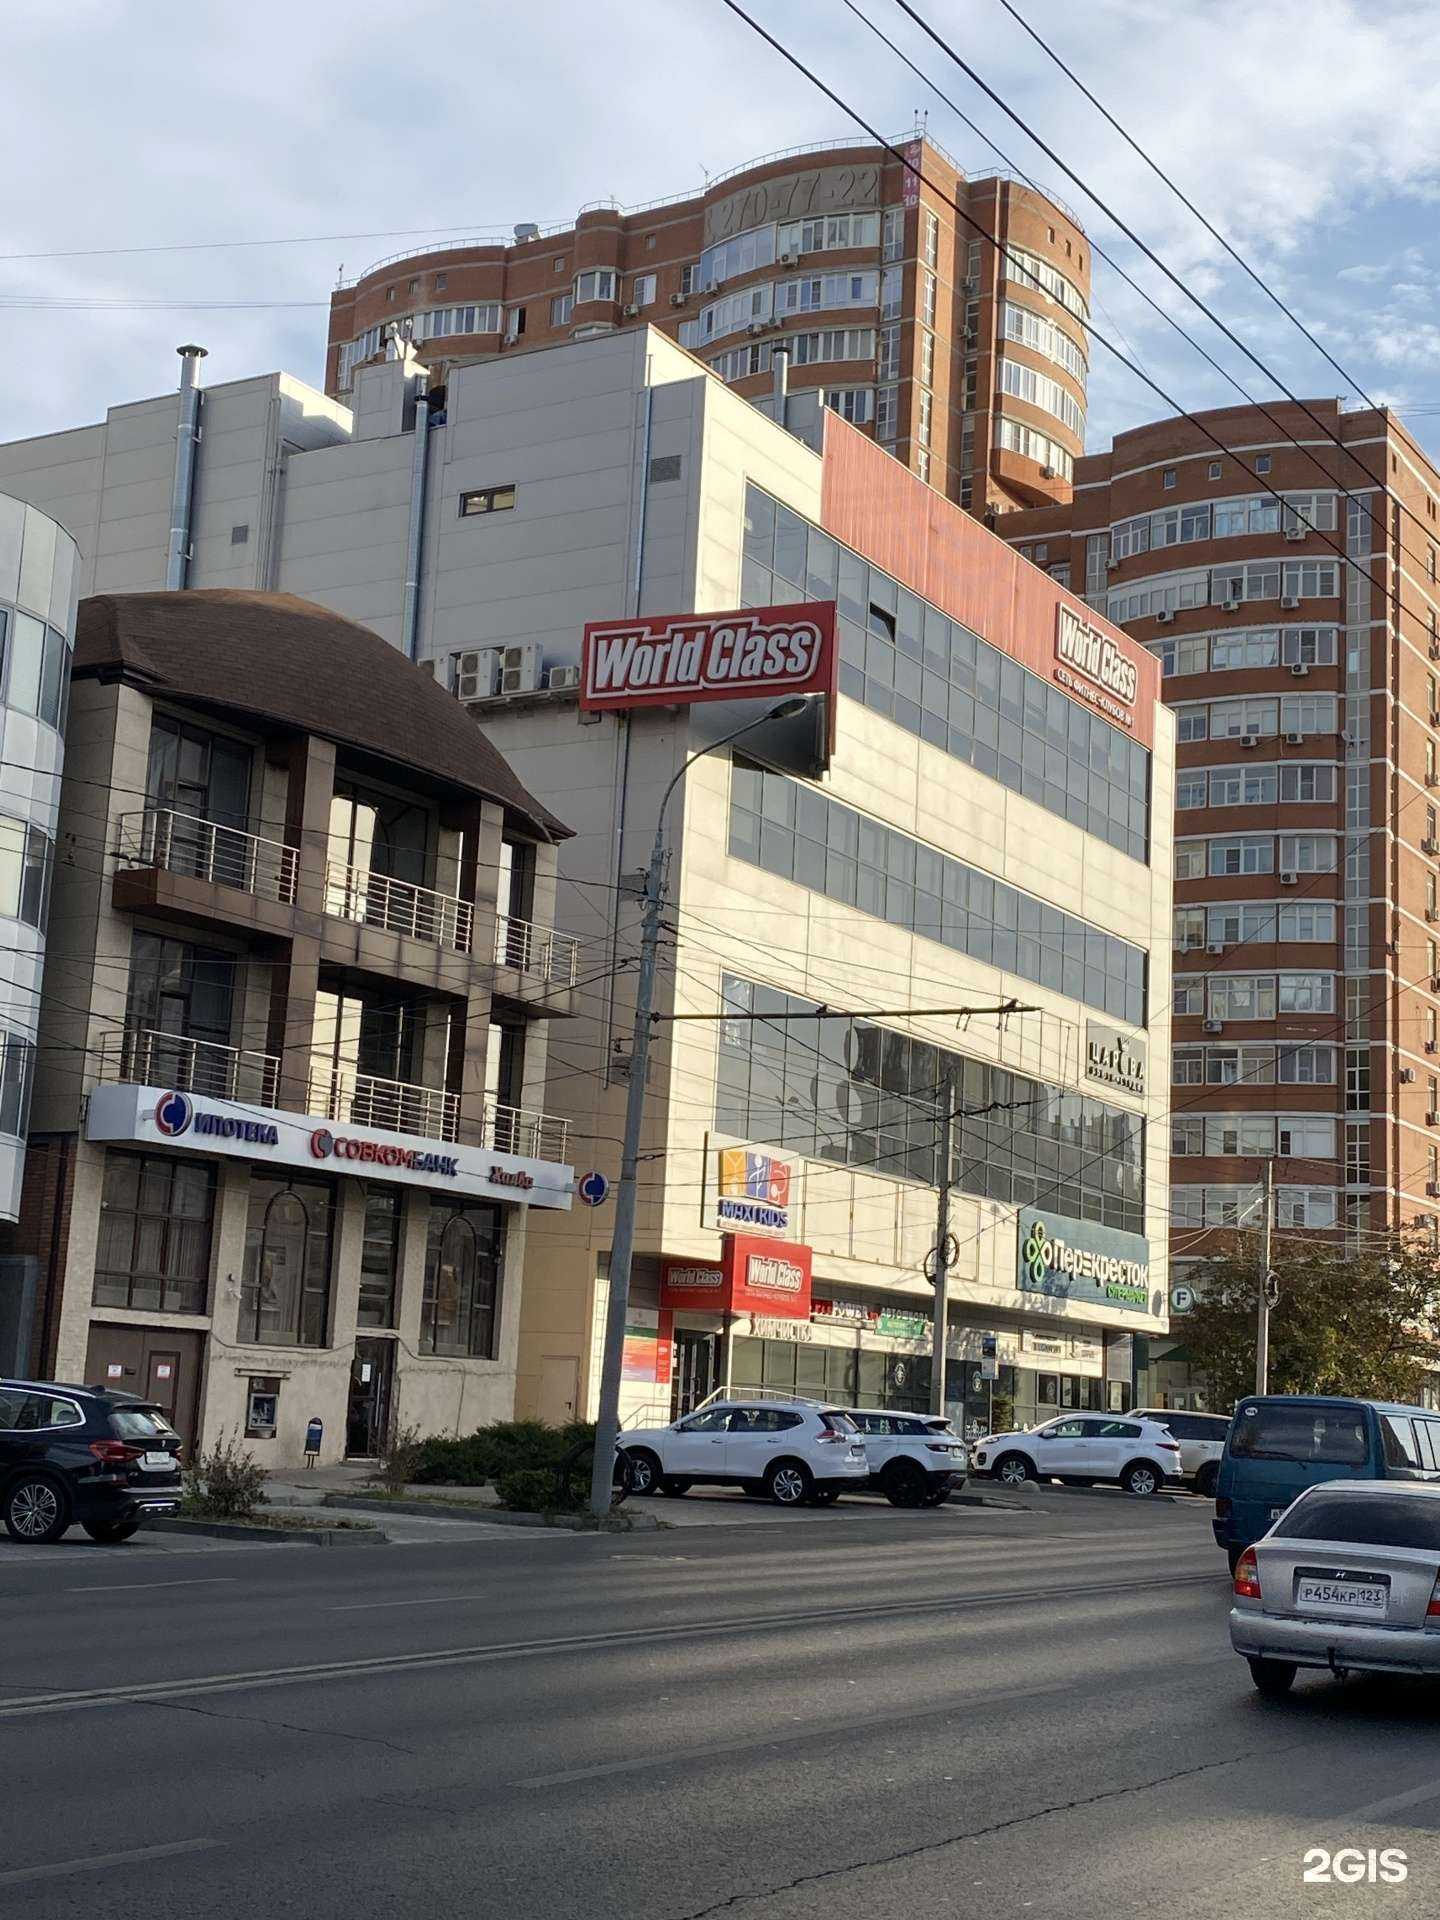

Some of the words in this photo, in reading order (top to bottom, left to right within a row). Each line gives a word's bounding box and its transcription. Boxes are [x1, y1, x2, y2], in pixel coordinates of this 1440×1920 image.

[596, 630, 705, 689] World
[707, 626, 812, 681] Class
[1061, 612, 1102, 677] World
[1101, 642, 1136, 700] Class
[194, 1112, 279, 1145] ИПОТЕКА
[334, 1136, 459, 1176] СОВКОМБАНК
[719, 1200, 757, 1222] MAXI
[759, 1207, 789, 1228] KIDS
[669, 1269, 696, 1285] World
[697, 1270, 721, 1285] Class
[750, 1257, 777, 1286] World
[777, 1262, 802, 1290] Class
[751, 1316, 813, 1342] ХИМЧИСТКА
